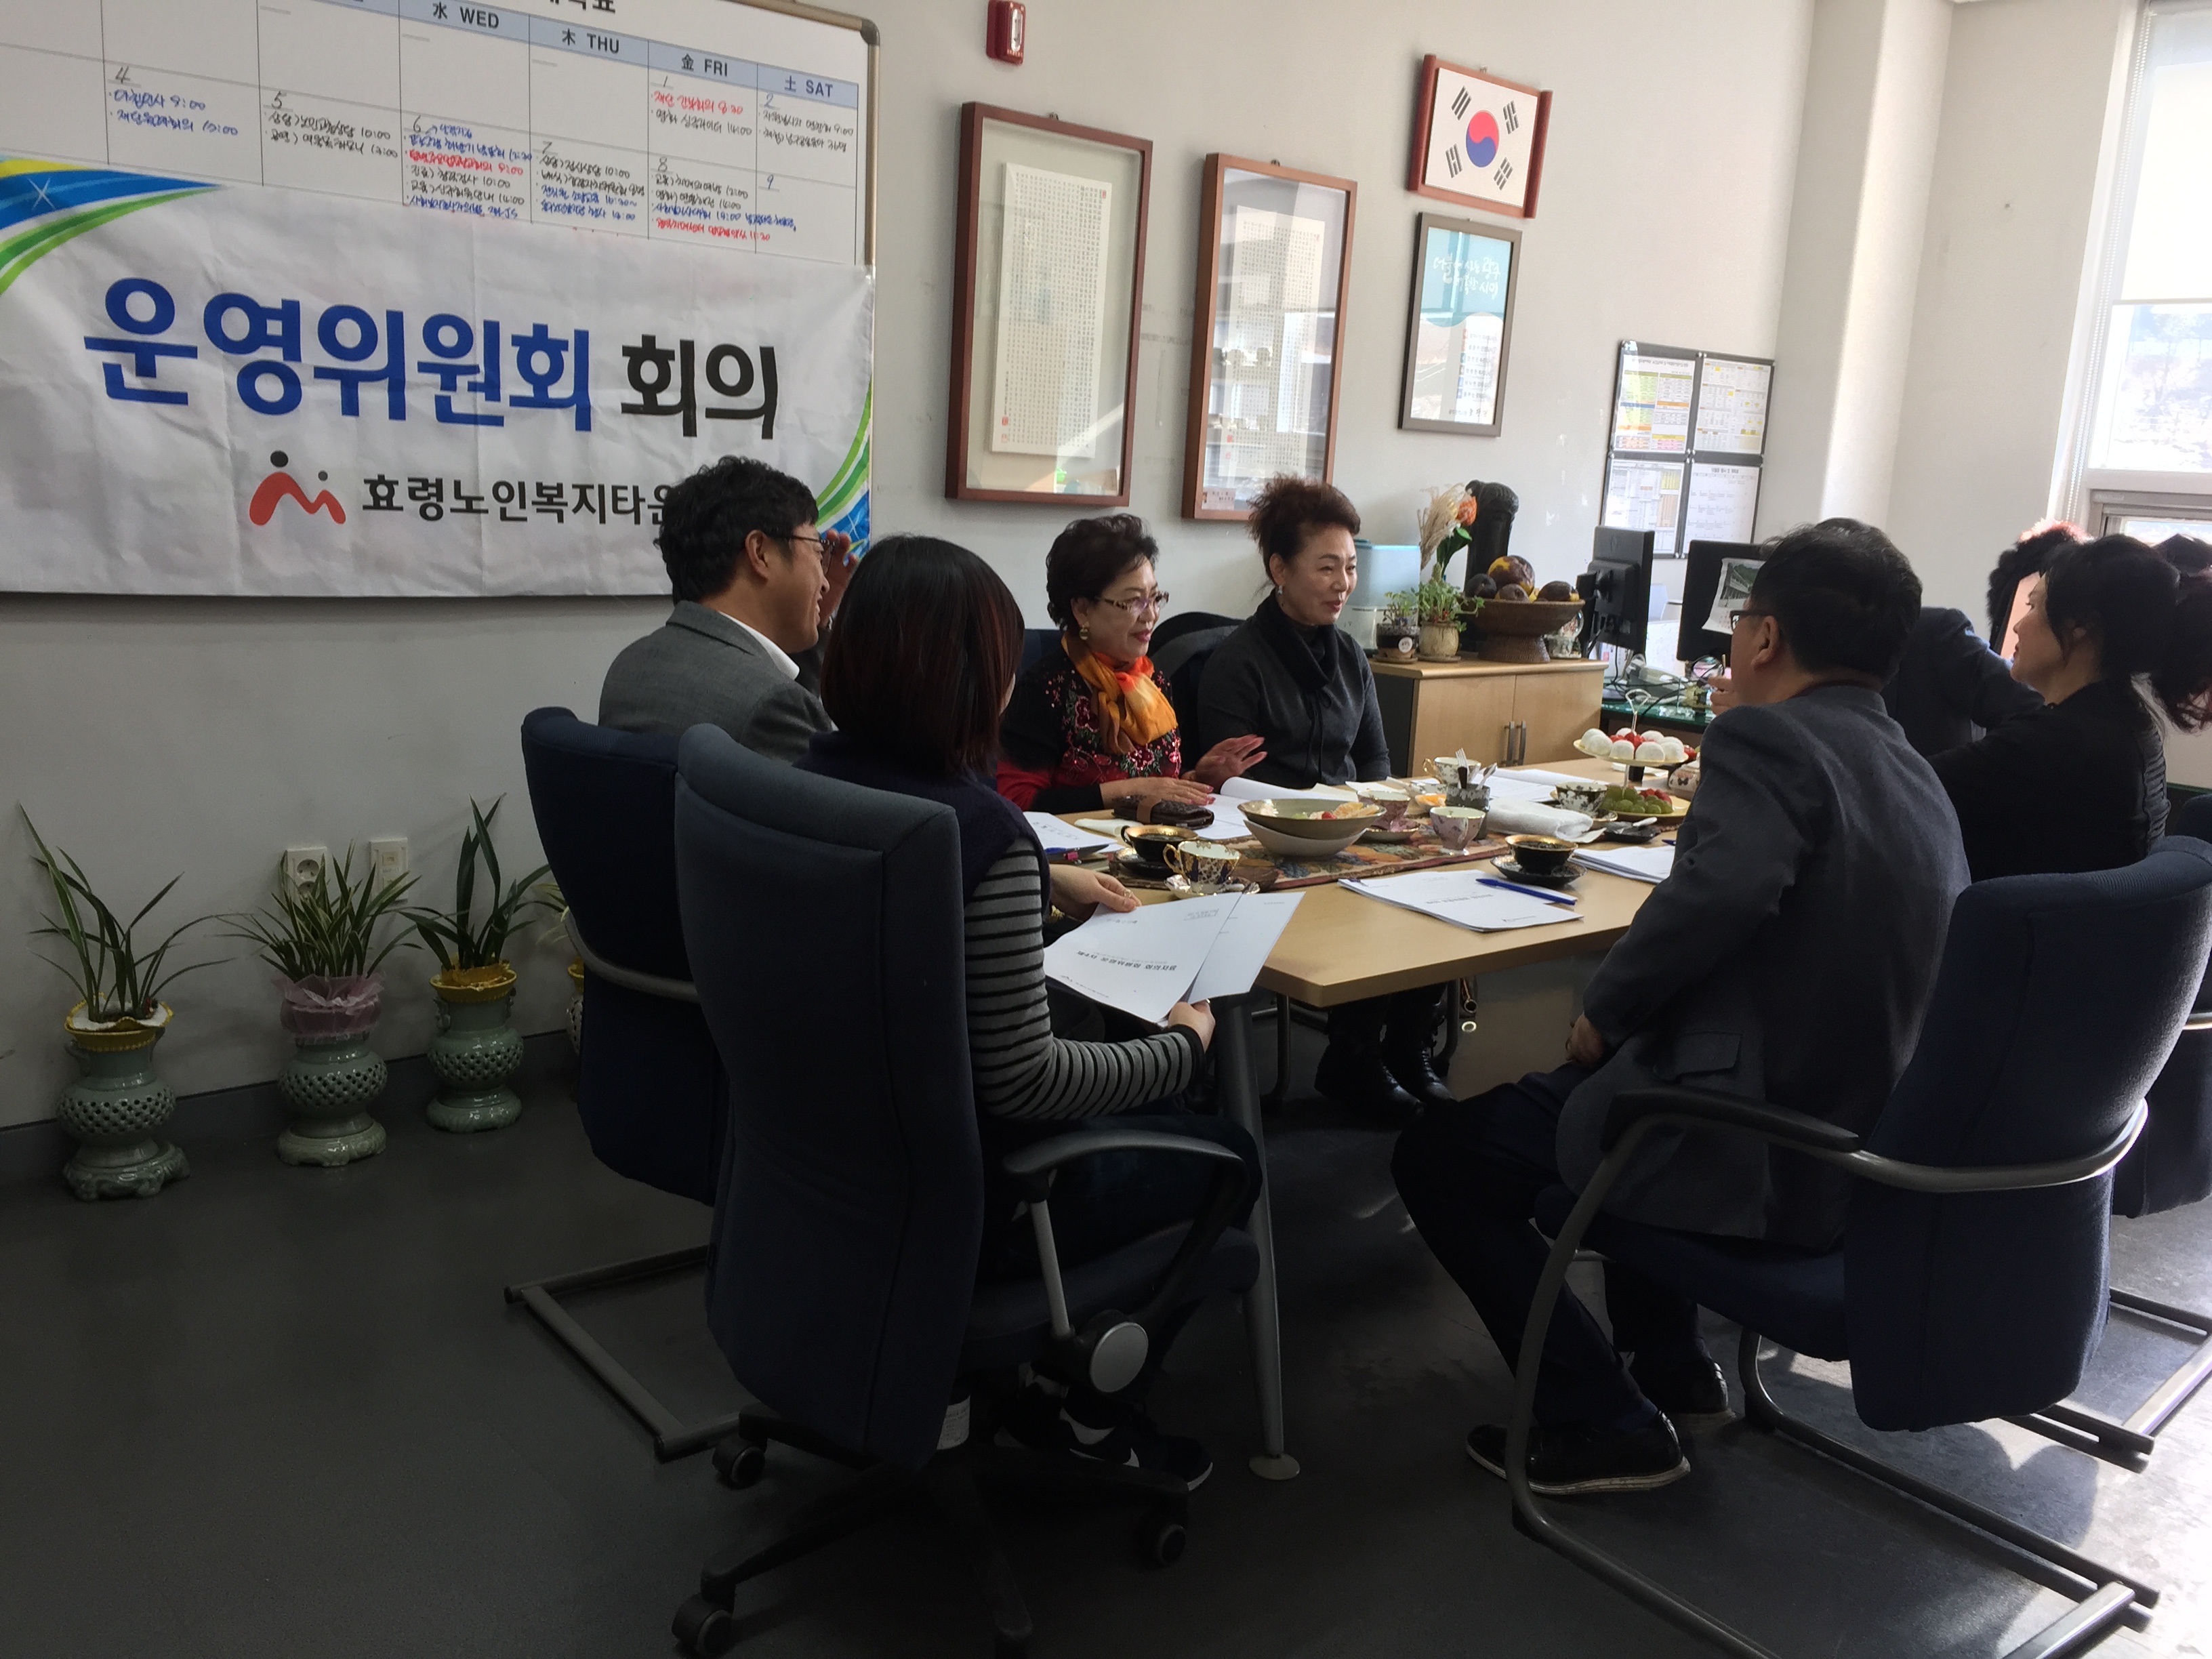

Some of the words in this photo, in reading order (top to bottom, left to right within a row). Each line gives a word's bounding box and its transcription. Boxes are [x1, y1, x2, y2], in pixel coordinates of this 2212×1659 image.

[432, 1, 448, 19] 水
[459, 6, 499, 28] WED
[562, 28, 576, 46] 木
[586, 32, 619, 54] THU
[681, 53, 695, 73] 金
[704, 58, 728, 77] FRI
[115, 66, 131, 85] 4
[784, 75, 797, 93] 土
[806, 79, 834, 98] SAT
[170, 94, 206, 108] 9:00
[272, 91, 287, 109] 5
[764, 92, 779, 108] 2
[361, 126, 391, 140] 10:00
[413, 115, 422, 134] 6
[605, 165, 630, 180] 10:00
[658, 156, 668, 173] 8
[483, 175, 511, 189] 10:00
[767, 174, 775, 190] 9
[83, 276, 592, 432] 운영위원회
[621, 334, 779, 440] 회의
[362, 474, 671, 525] 효령노인복지타운
